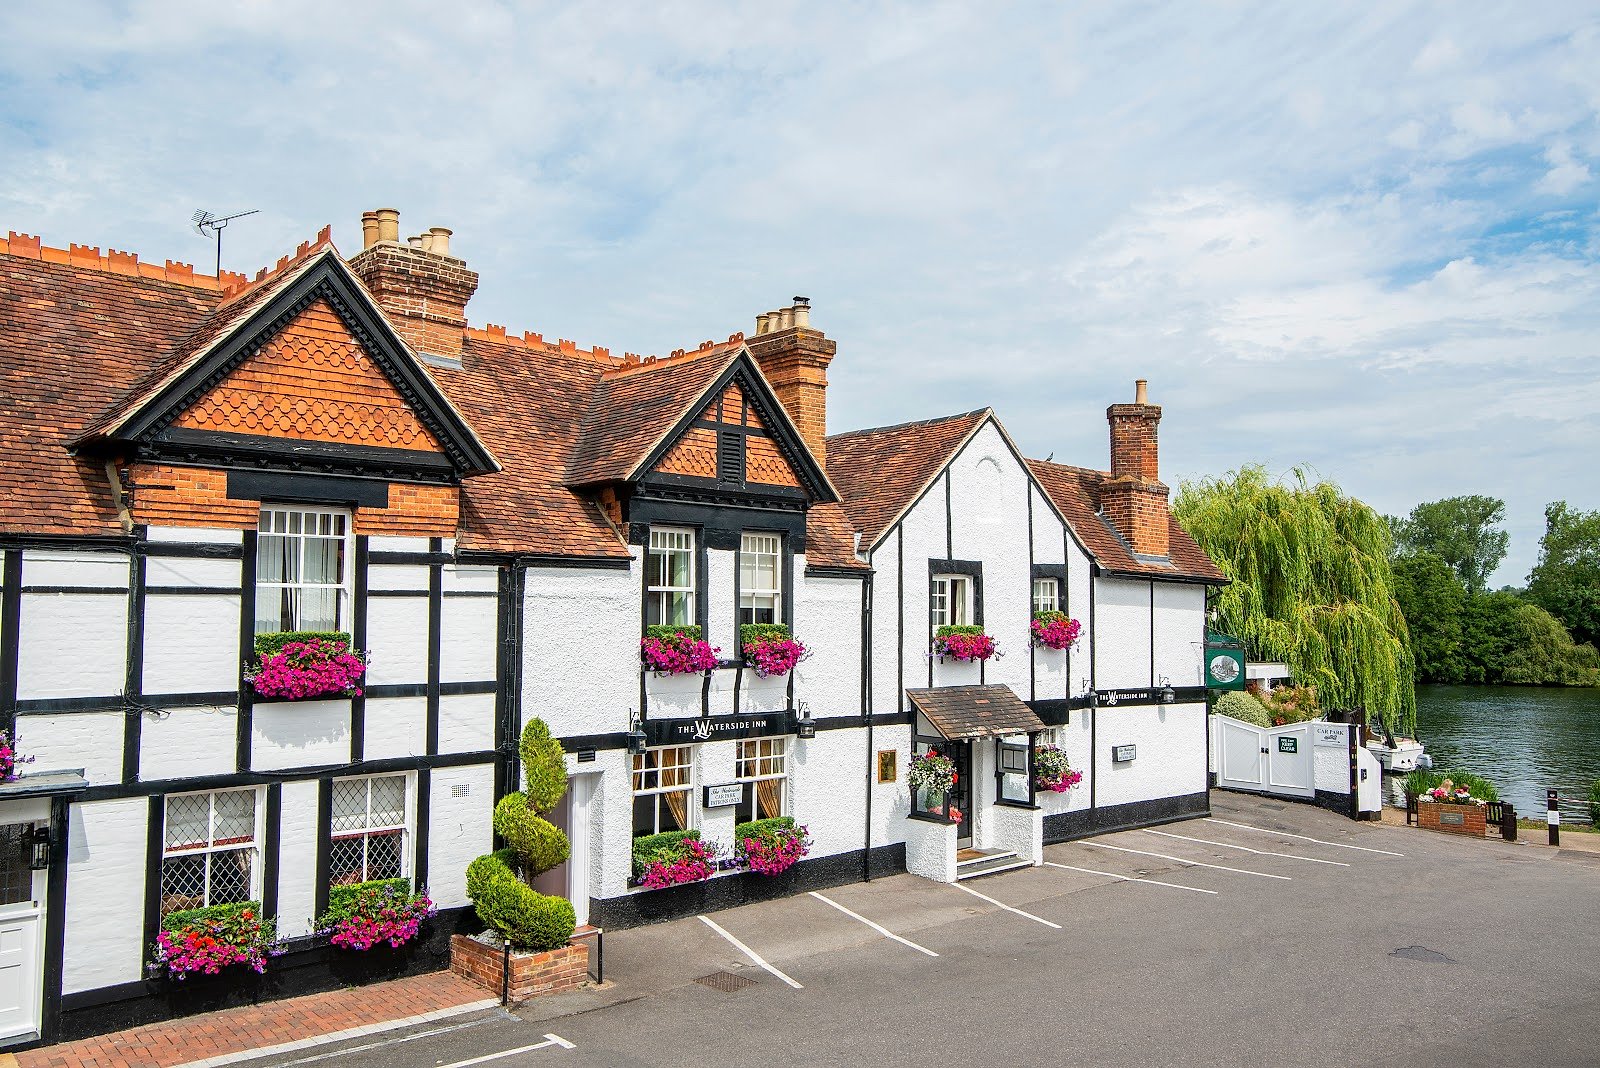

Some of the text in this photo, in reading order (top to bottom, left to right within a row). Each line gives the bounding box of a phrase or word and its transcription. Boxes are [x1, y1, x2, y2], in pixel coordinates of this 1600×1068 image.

[1107, 690, 1138, 705] WATERSIDE
[678, 719, 767, 739] THE WATERSIDE INN
